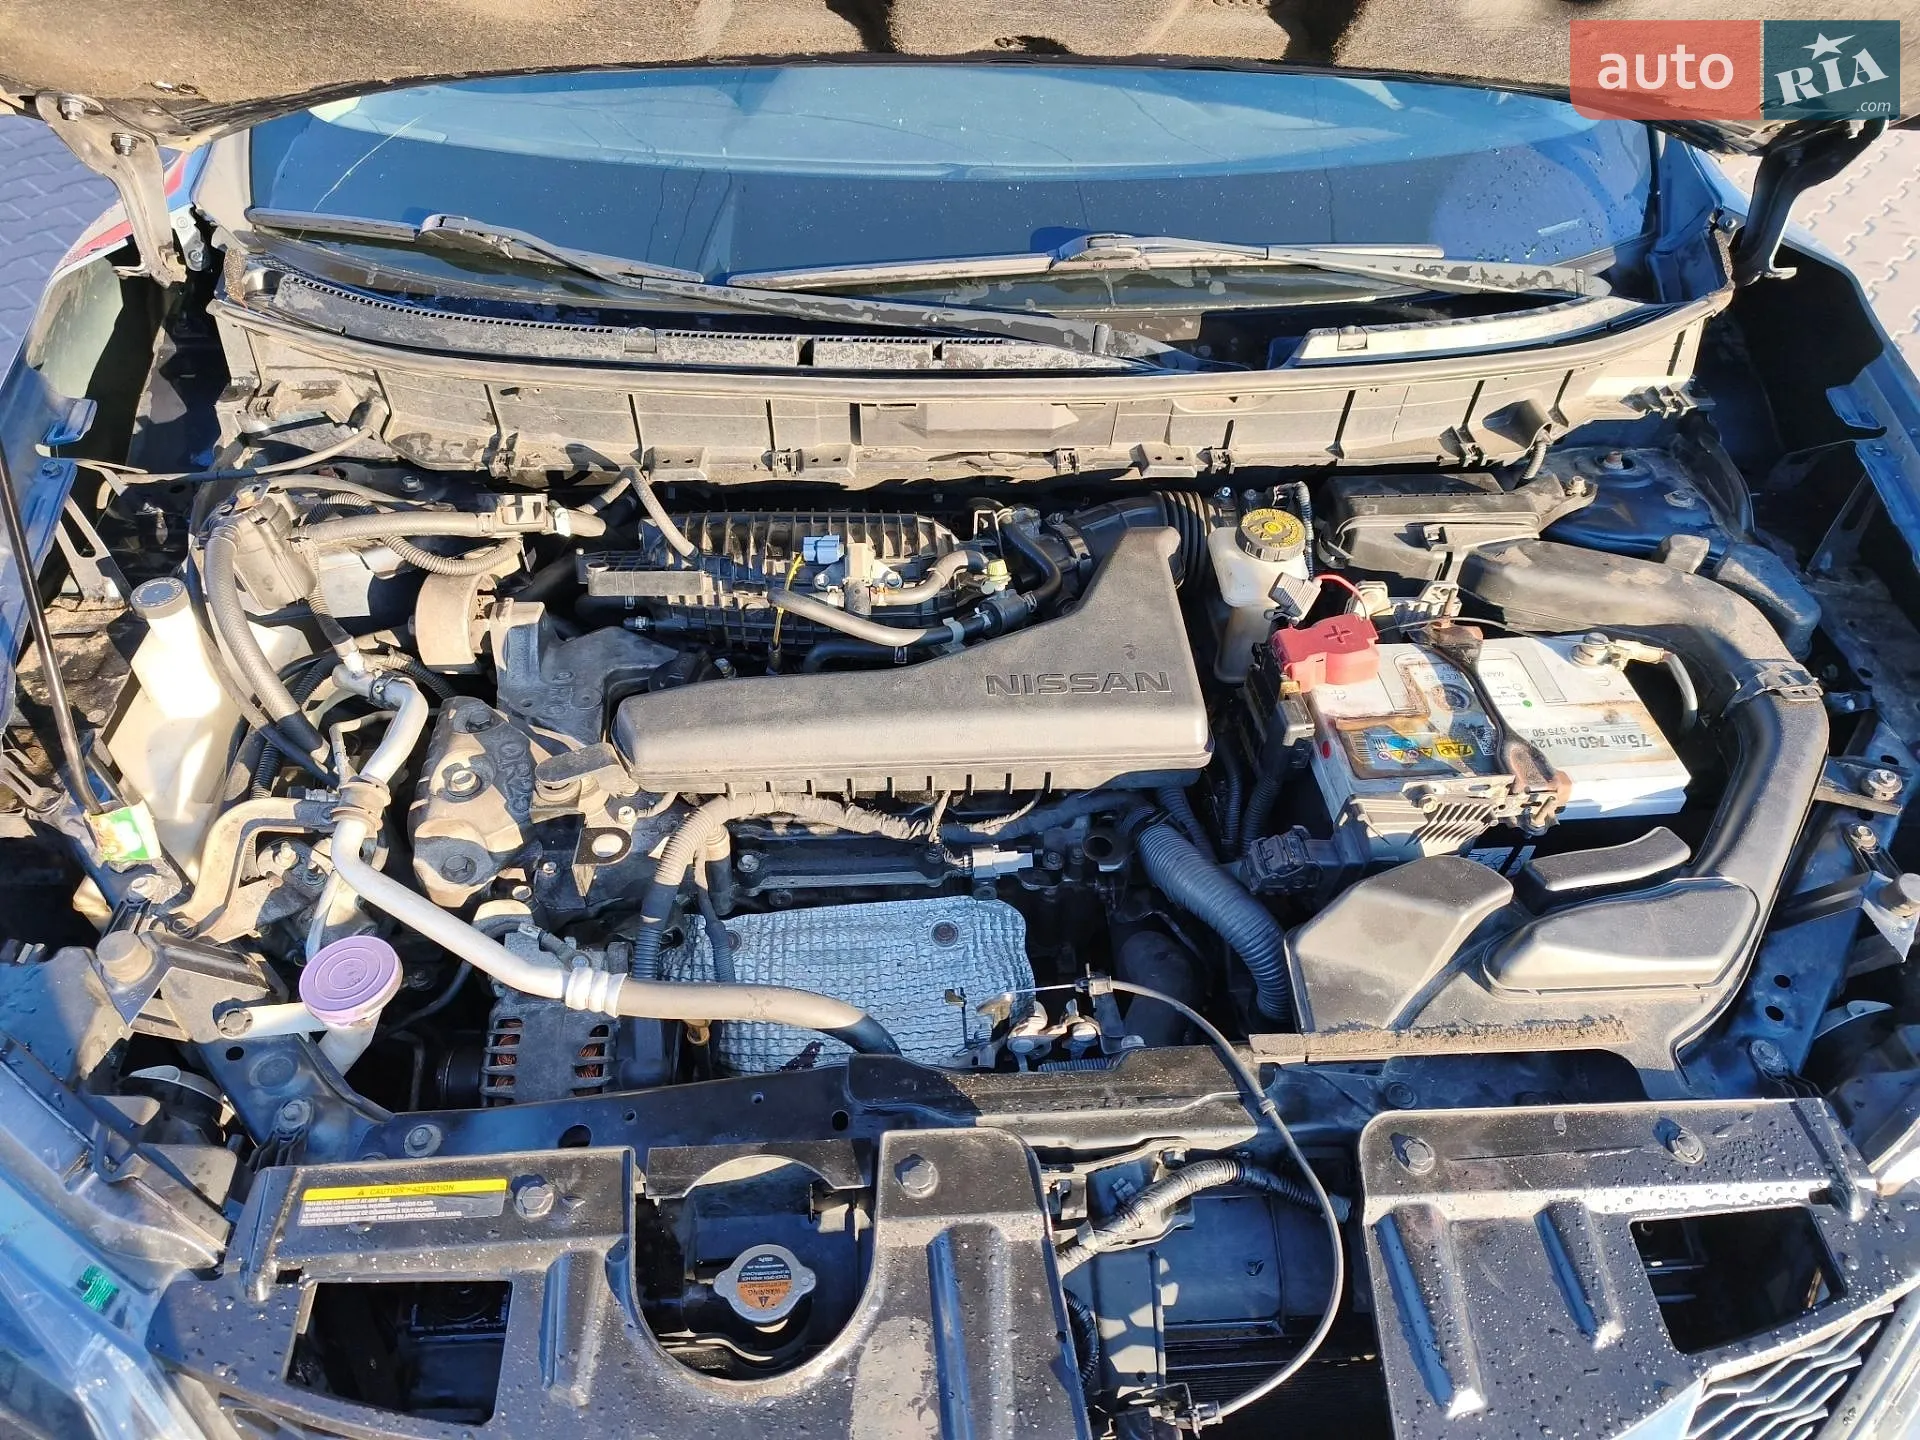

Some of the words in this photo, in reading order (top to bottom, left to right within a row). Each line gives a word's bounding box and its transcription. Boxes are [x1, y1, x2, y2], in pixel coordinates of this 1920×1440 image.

[985, 671, 1173, 696] NISSAN
[1580, 736, 1610, 749] 750
[1611, 734, 1652, 748] 75Ah
[370, 1187, 404, 1195] CAUTION
[412, 1184, 455, 1193] ATTENTION
[747, 1288, 781, 1297] WARNING
